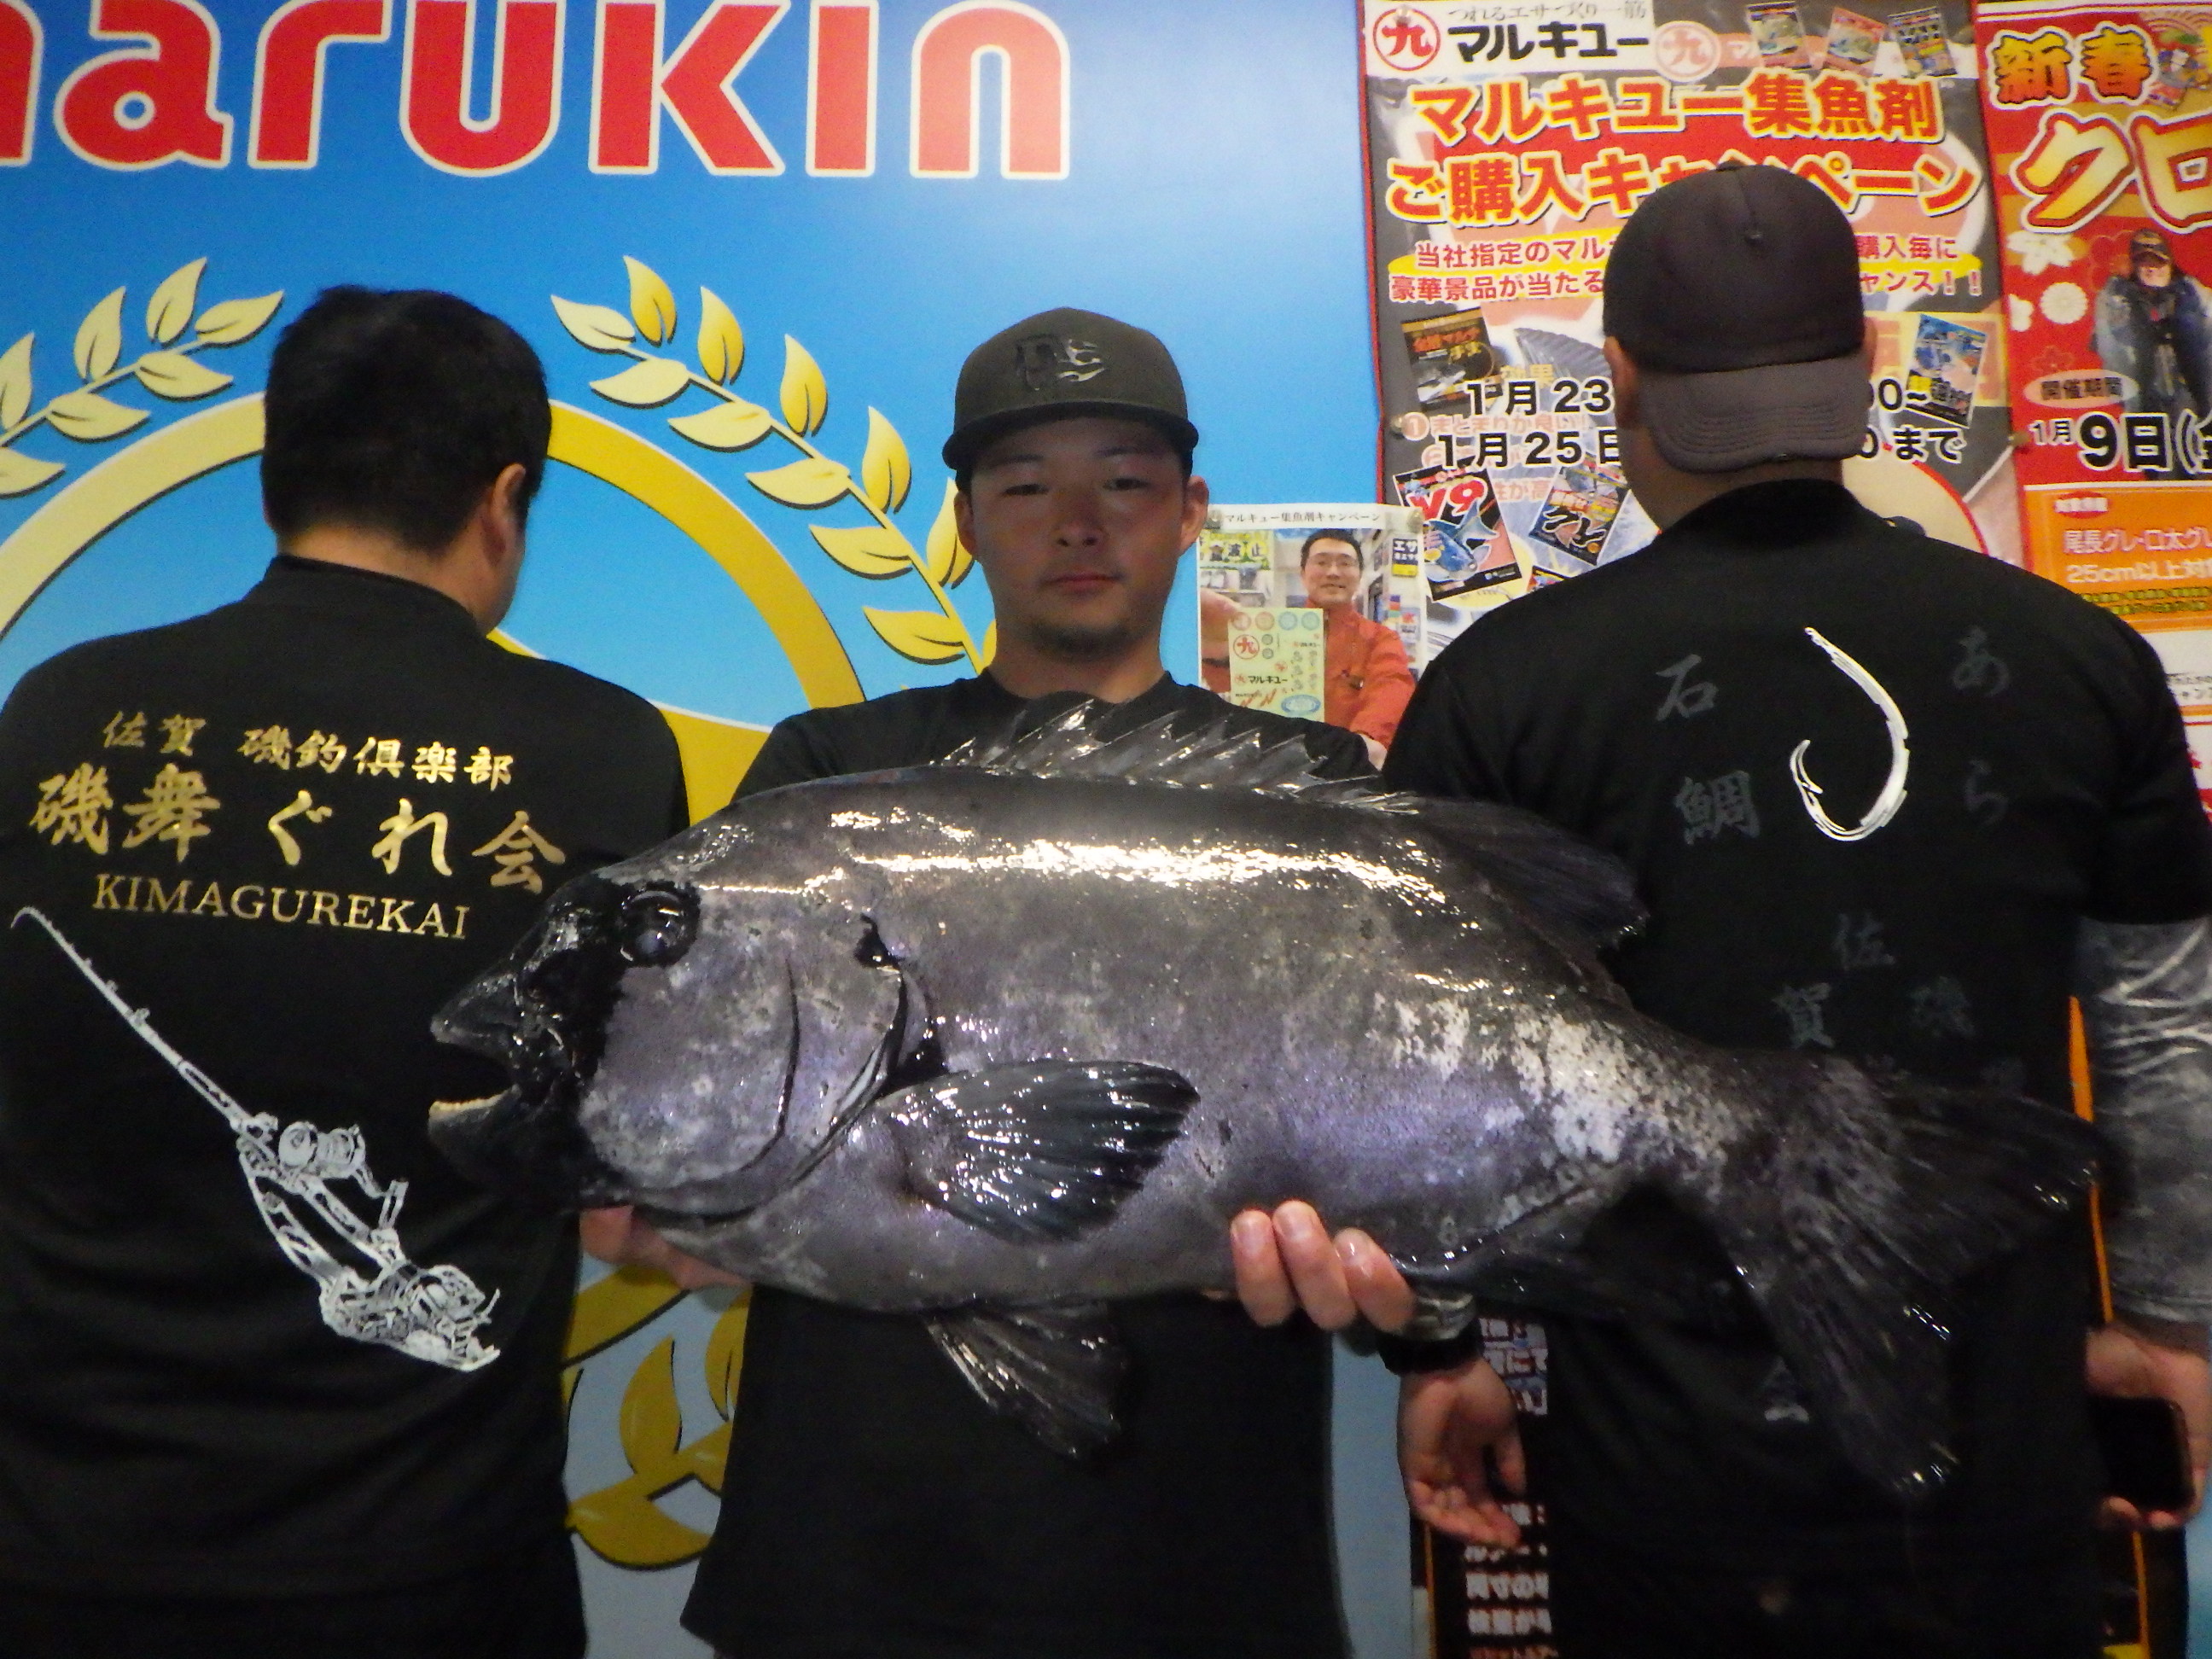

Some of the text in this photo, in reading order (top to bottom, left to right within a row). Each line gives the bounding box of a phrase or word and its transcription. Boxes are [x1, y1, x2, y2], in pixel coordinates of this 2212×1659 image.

[1991, 27, 2154, 105] 新春
[1417, 239, 1615, 268] 当社指定のマル
[102, 710, 206, 756] 佐賀
[93, 873, 471, 940] KIMAGUREKAI
